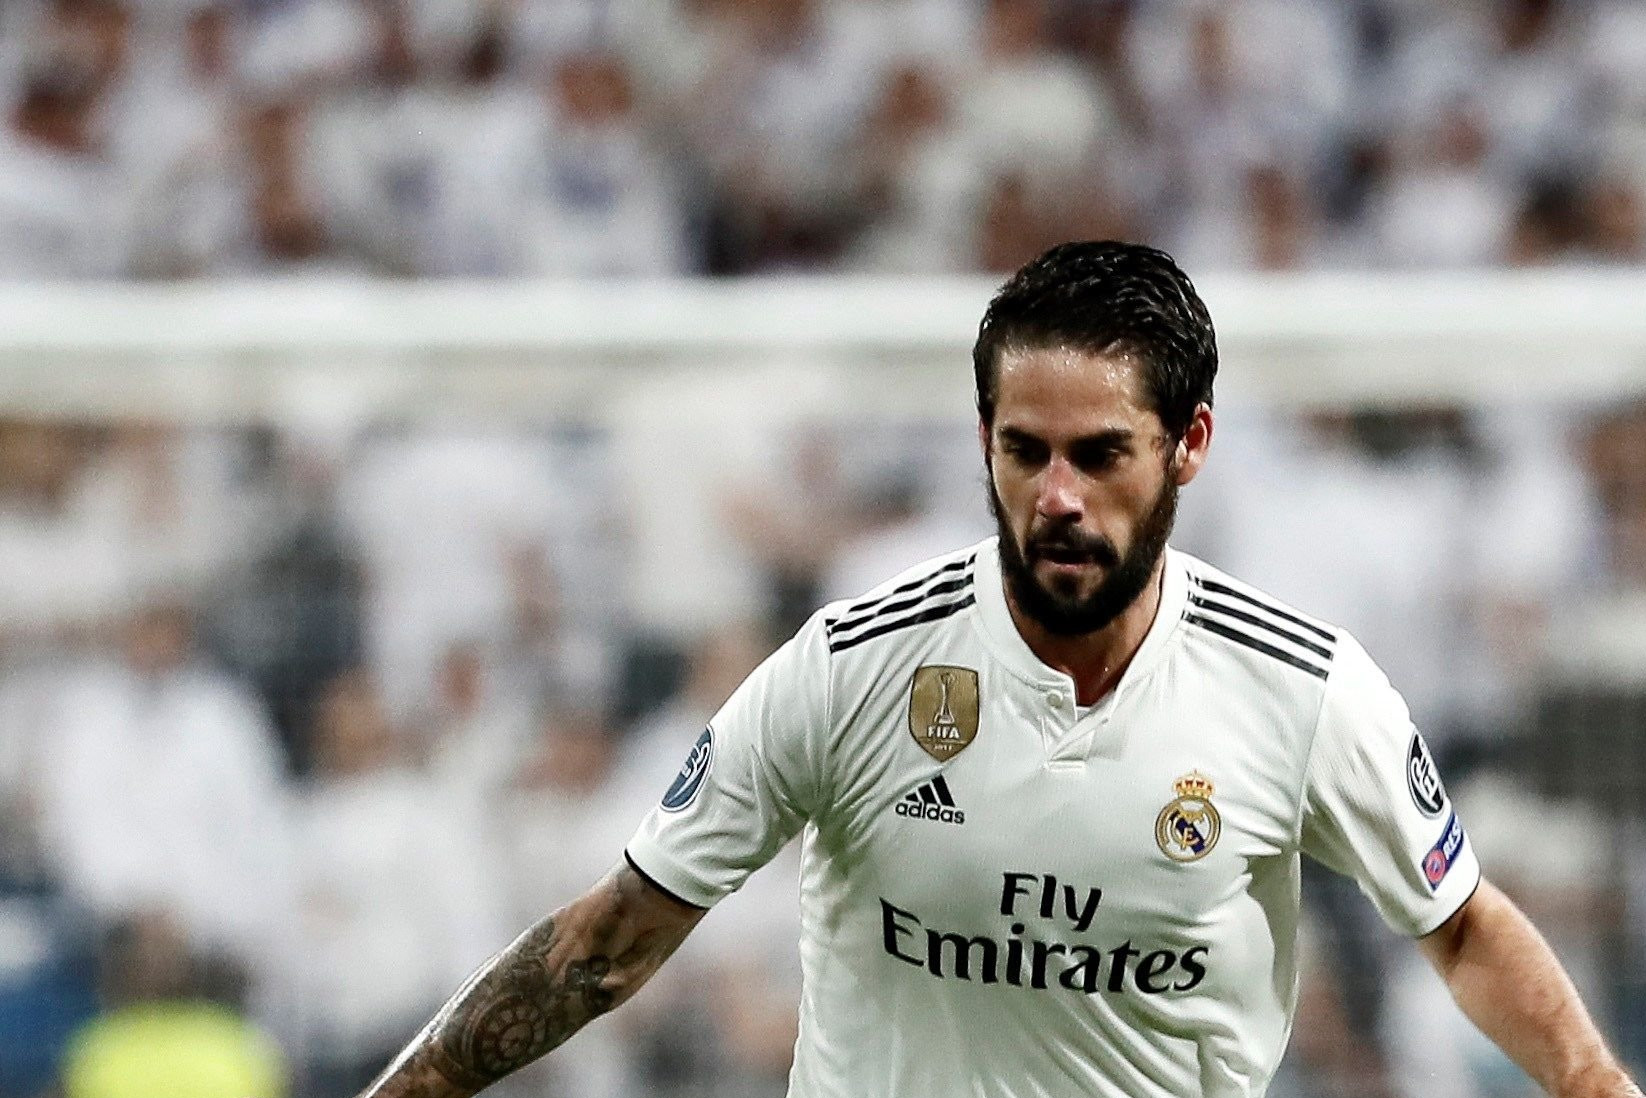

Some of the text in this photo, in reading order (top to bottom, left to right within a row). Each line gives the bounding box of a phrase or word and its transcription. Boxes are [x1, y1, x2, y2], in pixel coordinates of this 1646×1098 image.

[927, 724, 961, 740] FIFA
[895, 801, 965, 824] adidas
[1000, 872, 1102, 932] Fly
[879, 896, 1210, 995] Emirates
